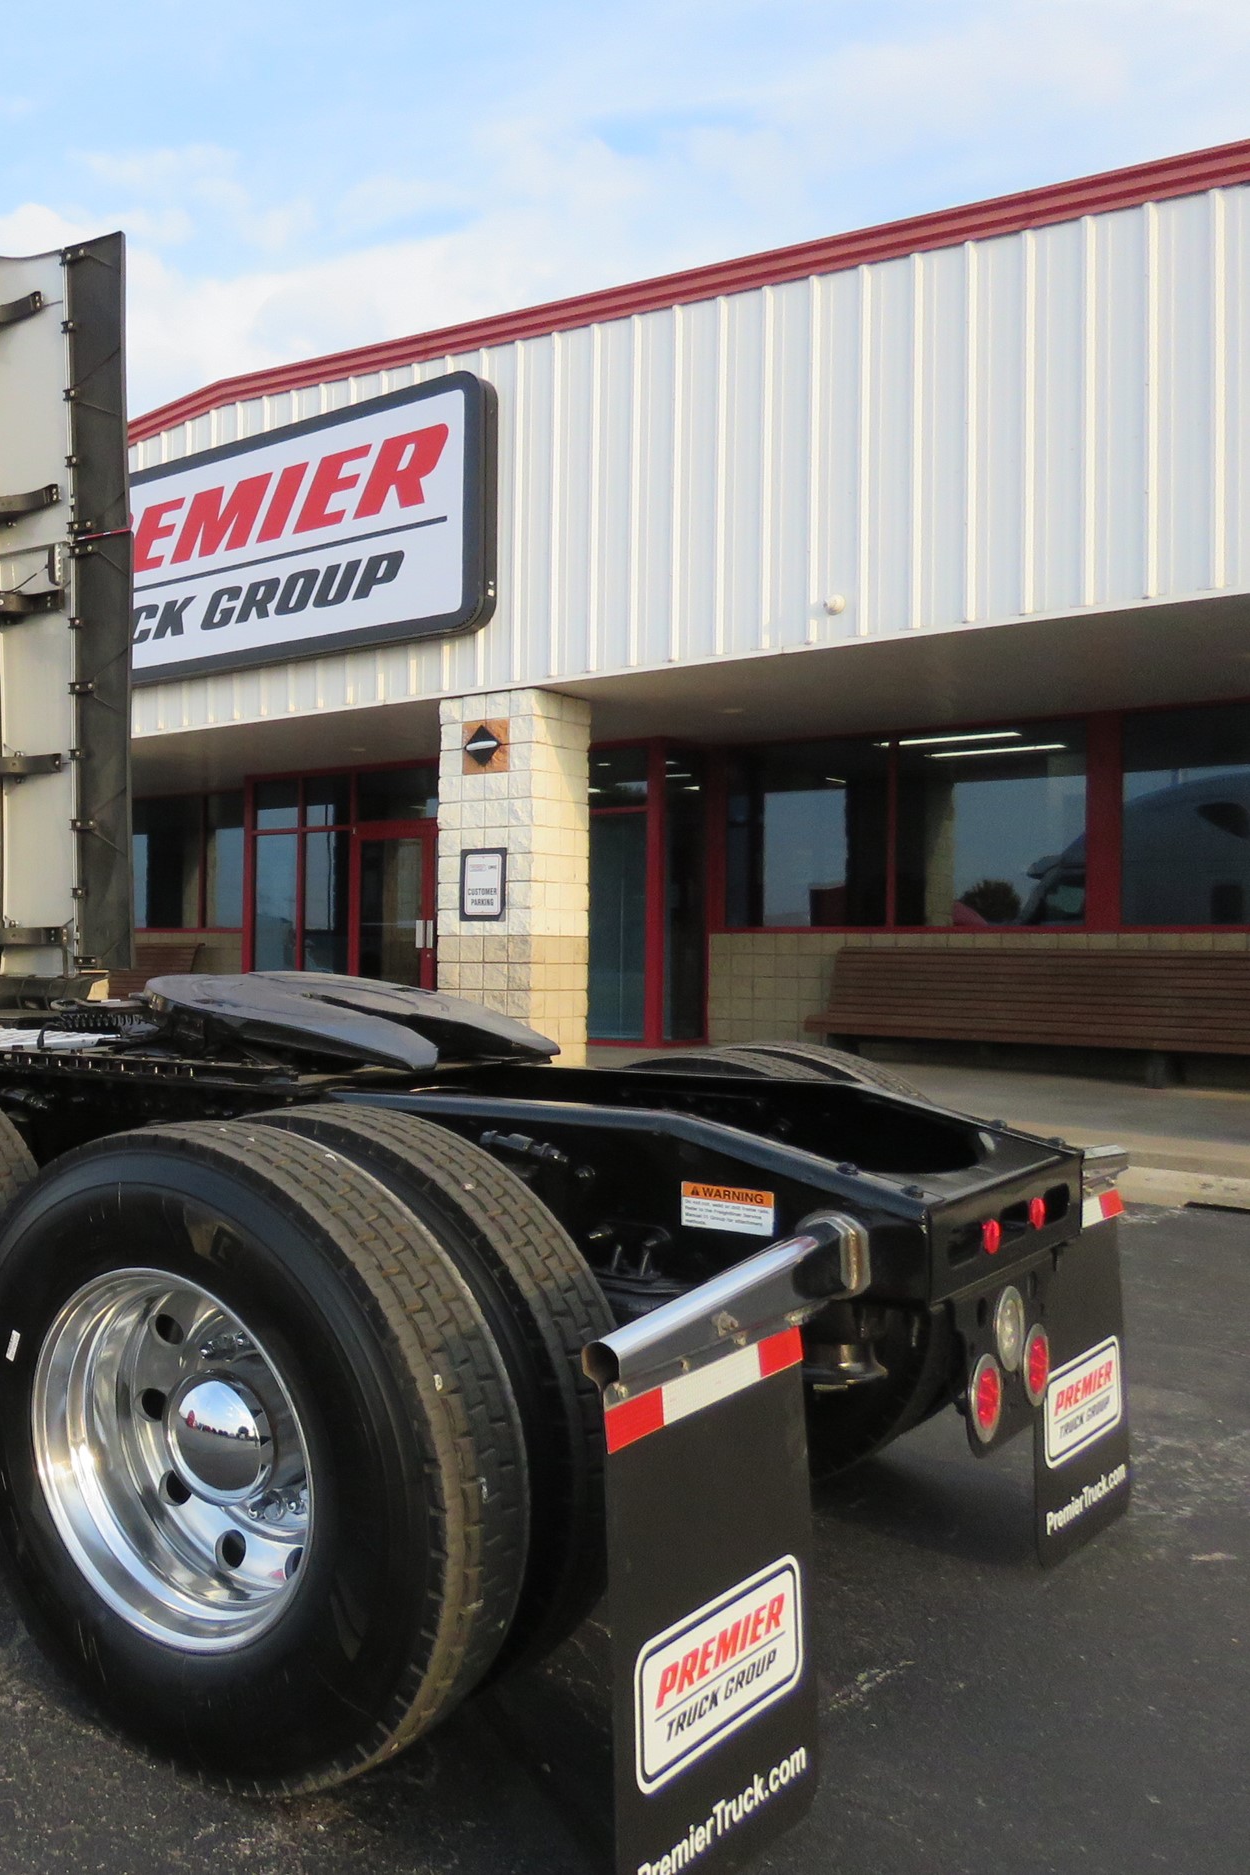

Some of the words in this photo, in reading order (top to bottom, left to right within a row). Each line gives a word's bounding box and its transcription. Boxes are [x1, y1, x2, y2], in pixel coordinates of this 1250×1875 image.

[130, 423, 449, 573] EMIER
[200, 550, 405, 631] GROUP
[467, 888, 497, 896] CUSTOMER
[470, 898, 494, 906] PARKING
[702, 1187, 764, 1204] WARNING
[1054, 1360, 1113, 1417] PREMIER
[1059, 1412, 1086, 1440] TRUCK
[1086, 1394, 1111, 1421] GROUP
[1046, 1463, 1127, 1536] PremierTruck.com
[655, 1592, 785, 1710] PREMIER
[665, 1685, 720, 1742] TRUCK
[723, 1647, 778, 1701] GROUP
